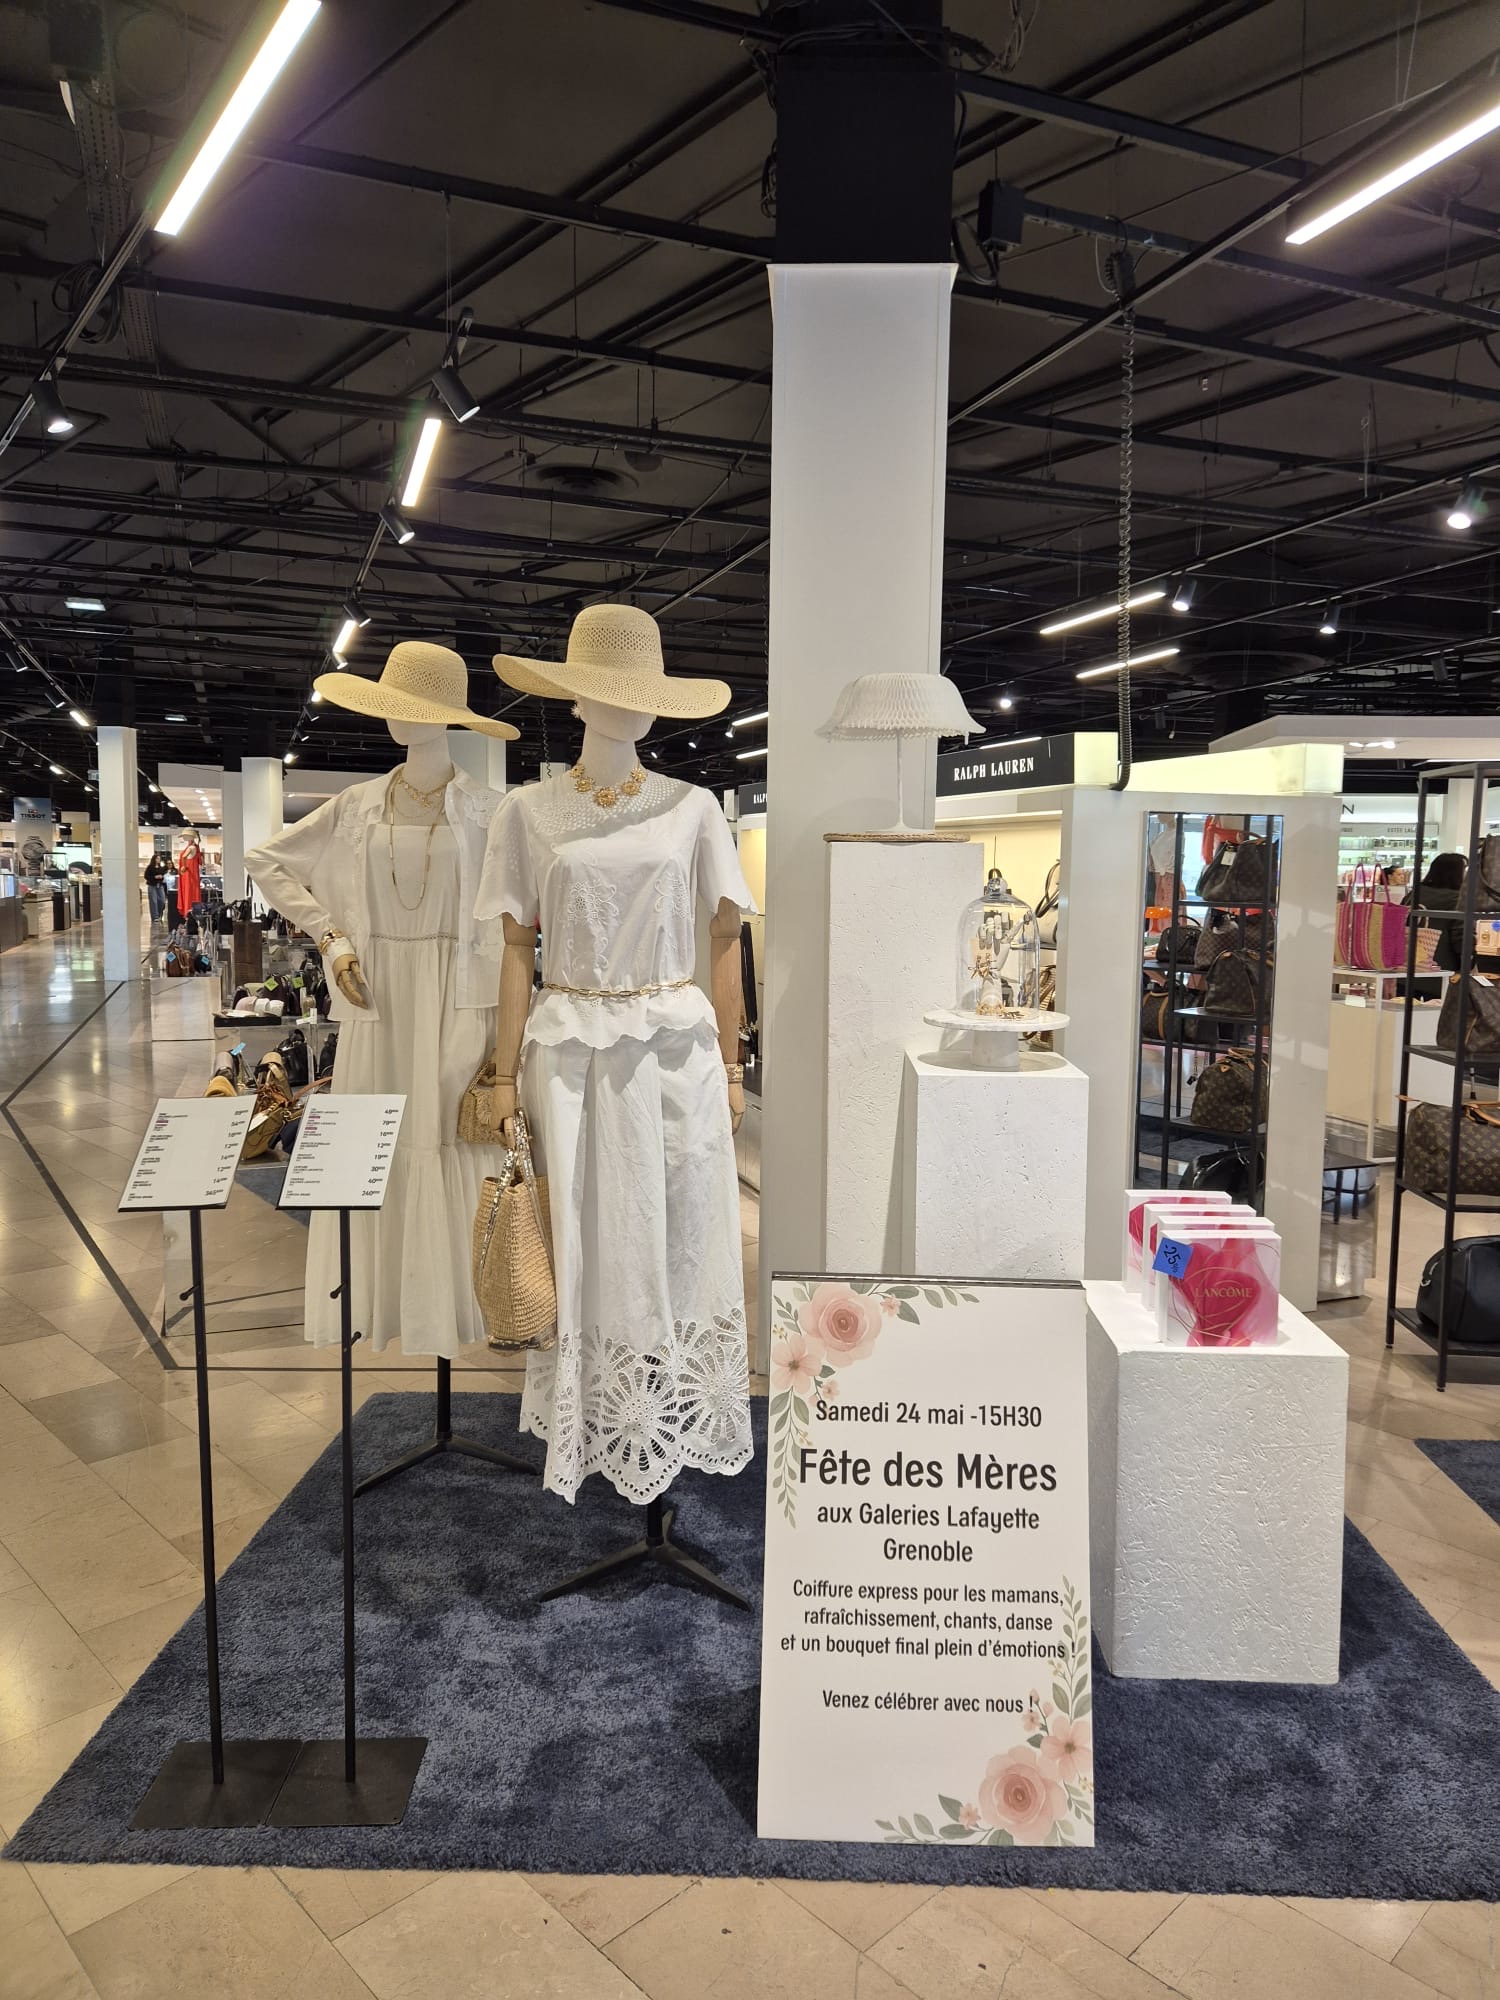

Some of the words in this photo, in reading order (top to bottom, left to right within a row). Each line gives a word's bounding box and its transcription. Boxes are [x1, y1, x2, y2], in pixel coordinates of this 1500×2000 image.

[954, 763, 986, 781] RALPH
[991, 757, 1034, 777] LAUREN
[1164, 1244, 1182, 1273] -25%
[1194, 1286, 1253, 1298] LANCÔME
[815, 1399, 889, 1423] Samedi
[896, 1402, 921, 1424] 24
[928, 1404, 964, 1425] mai
[970, 1405, 1042, 1428] -15H30
[799, 1448, 871, 1486] Fête
[883, 1451, 943, 1488] des
[957, 1453, 1057, 1492] Mères
[817, 1506, 852, 1524] aux
[859, 1502, 940, 1527] Galeries
[947, 1505, 1040, 1534] Lafayette
[883, 1538, 973, 1562] Grenoble
[793, 1579, 853, 1599] Coiffure
[858, 1585, 918, 1605] express
[923, 1587, 959, 1605] pour
[964, 1584, 986, 1602] les
[991, 1589, 1064, 1606] mamans,
[804, 1607, 940, 1631] rafraîchissement,
[943, 1611, 1002, 1633] chants,
[1005, 1613, 1053, 1631] danse
[780, 1634, 796, 1651] et
[801, 1638, 820, 1652] un
[826, 1635, 891, 1657] bouquet
[895, 1637, 929, 1655] final
[934, 1638, 972, 1660] plein
[977, 1639, 1066, 1659] d’émotions
[822, 1689, 869, 1709] Venez
[874, 1692, 939, 1711] célébrer
[944, 1697, 980, 1712] avec
[985, 1698, 1024, 1713] nous
